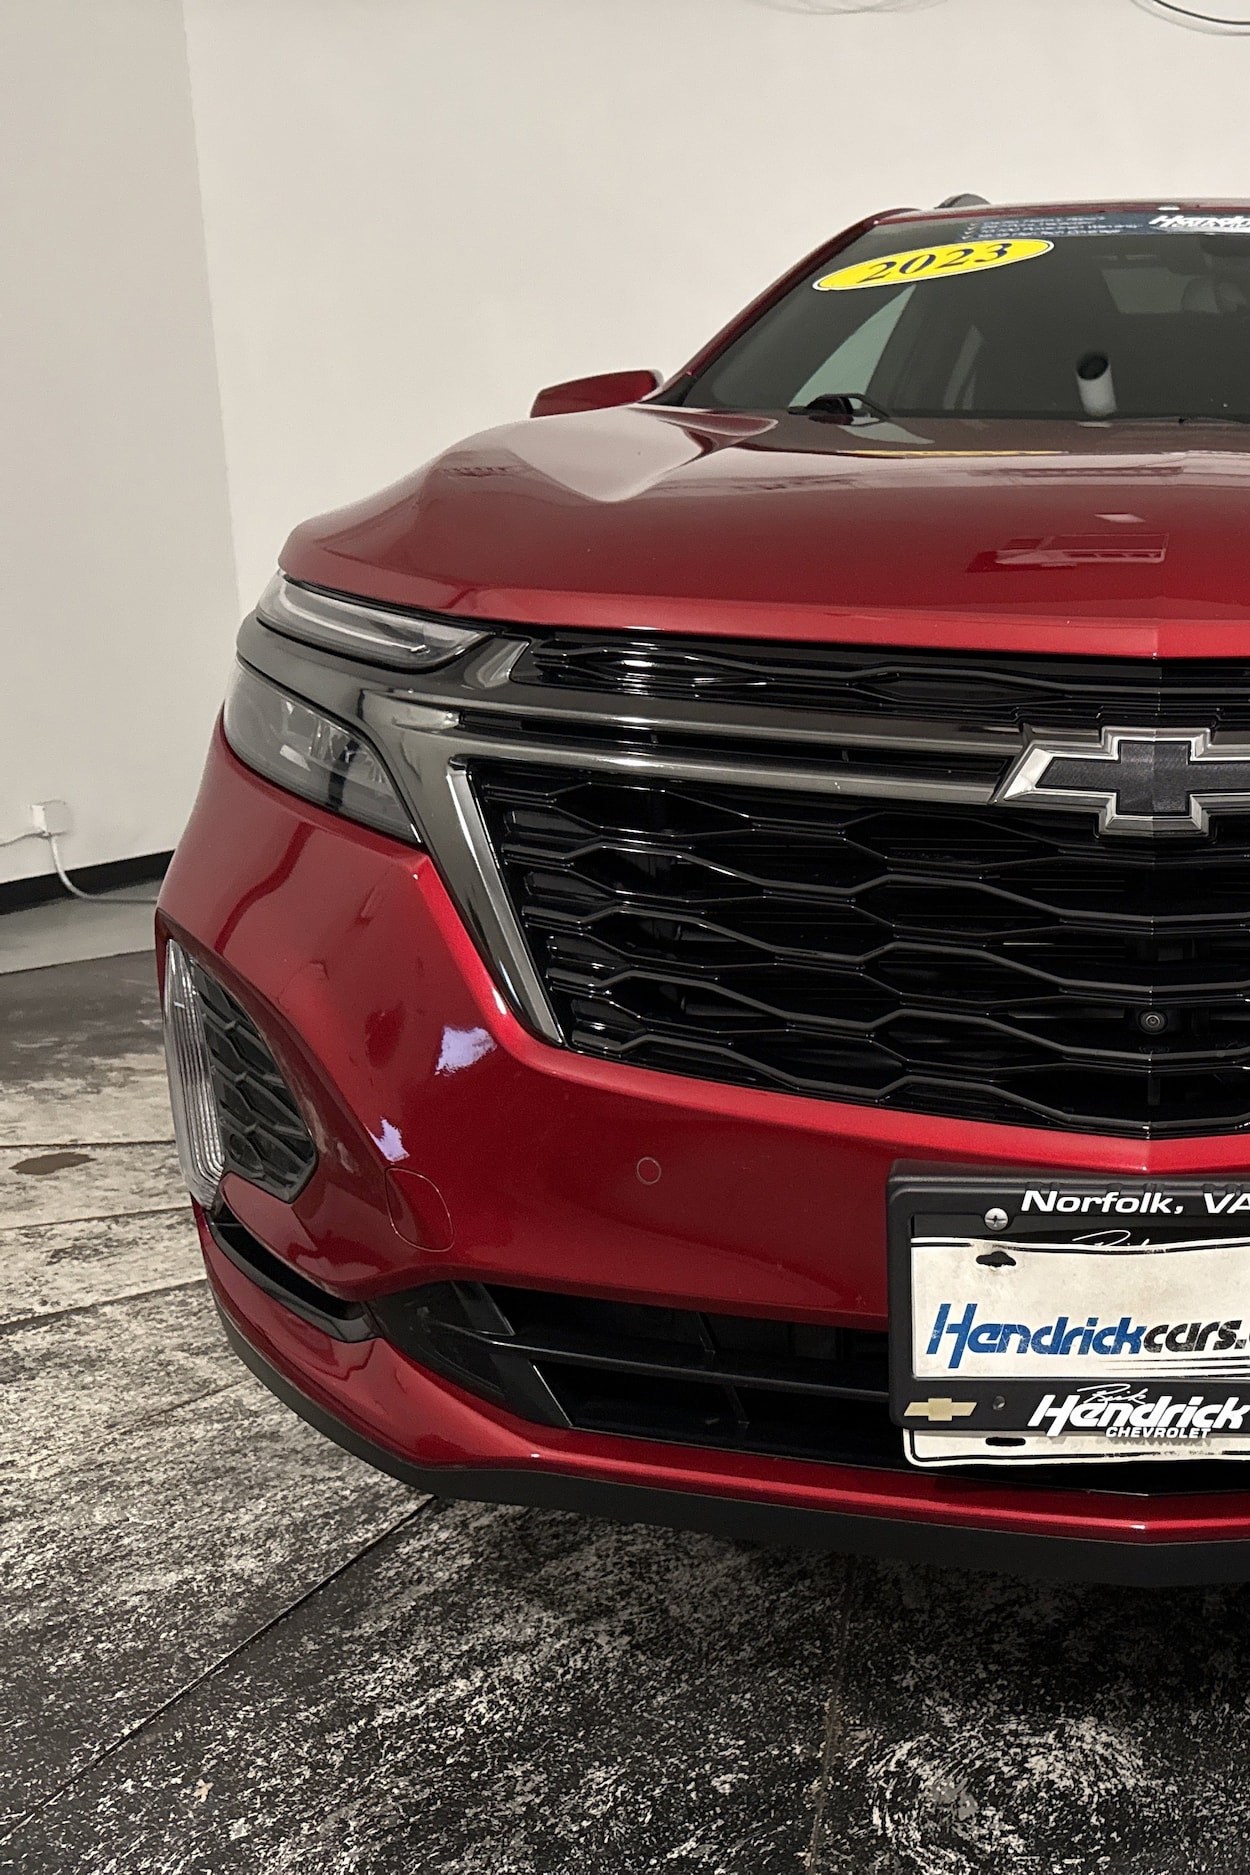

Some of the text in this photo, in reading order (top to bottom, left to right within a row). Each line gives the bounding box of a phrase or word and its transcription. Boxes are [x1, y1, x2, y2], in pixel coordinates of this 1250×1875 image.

[857, 243, 1012, 284] 2023
[1021, 1190, 1184, 1215] Norfolk,
[1105, 1426, 1212, 1439] CHEVROLET
